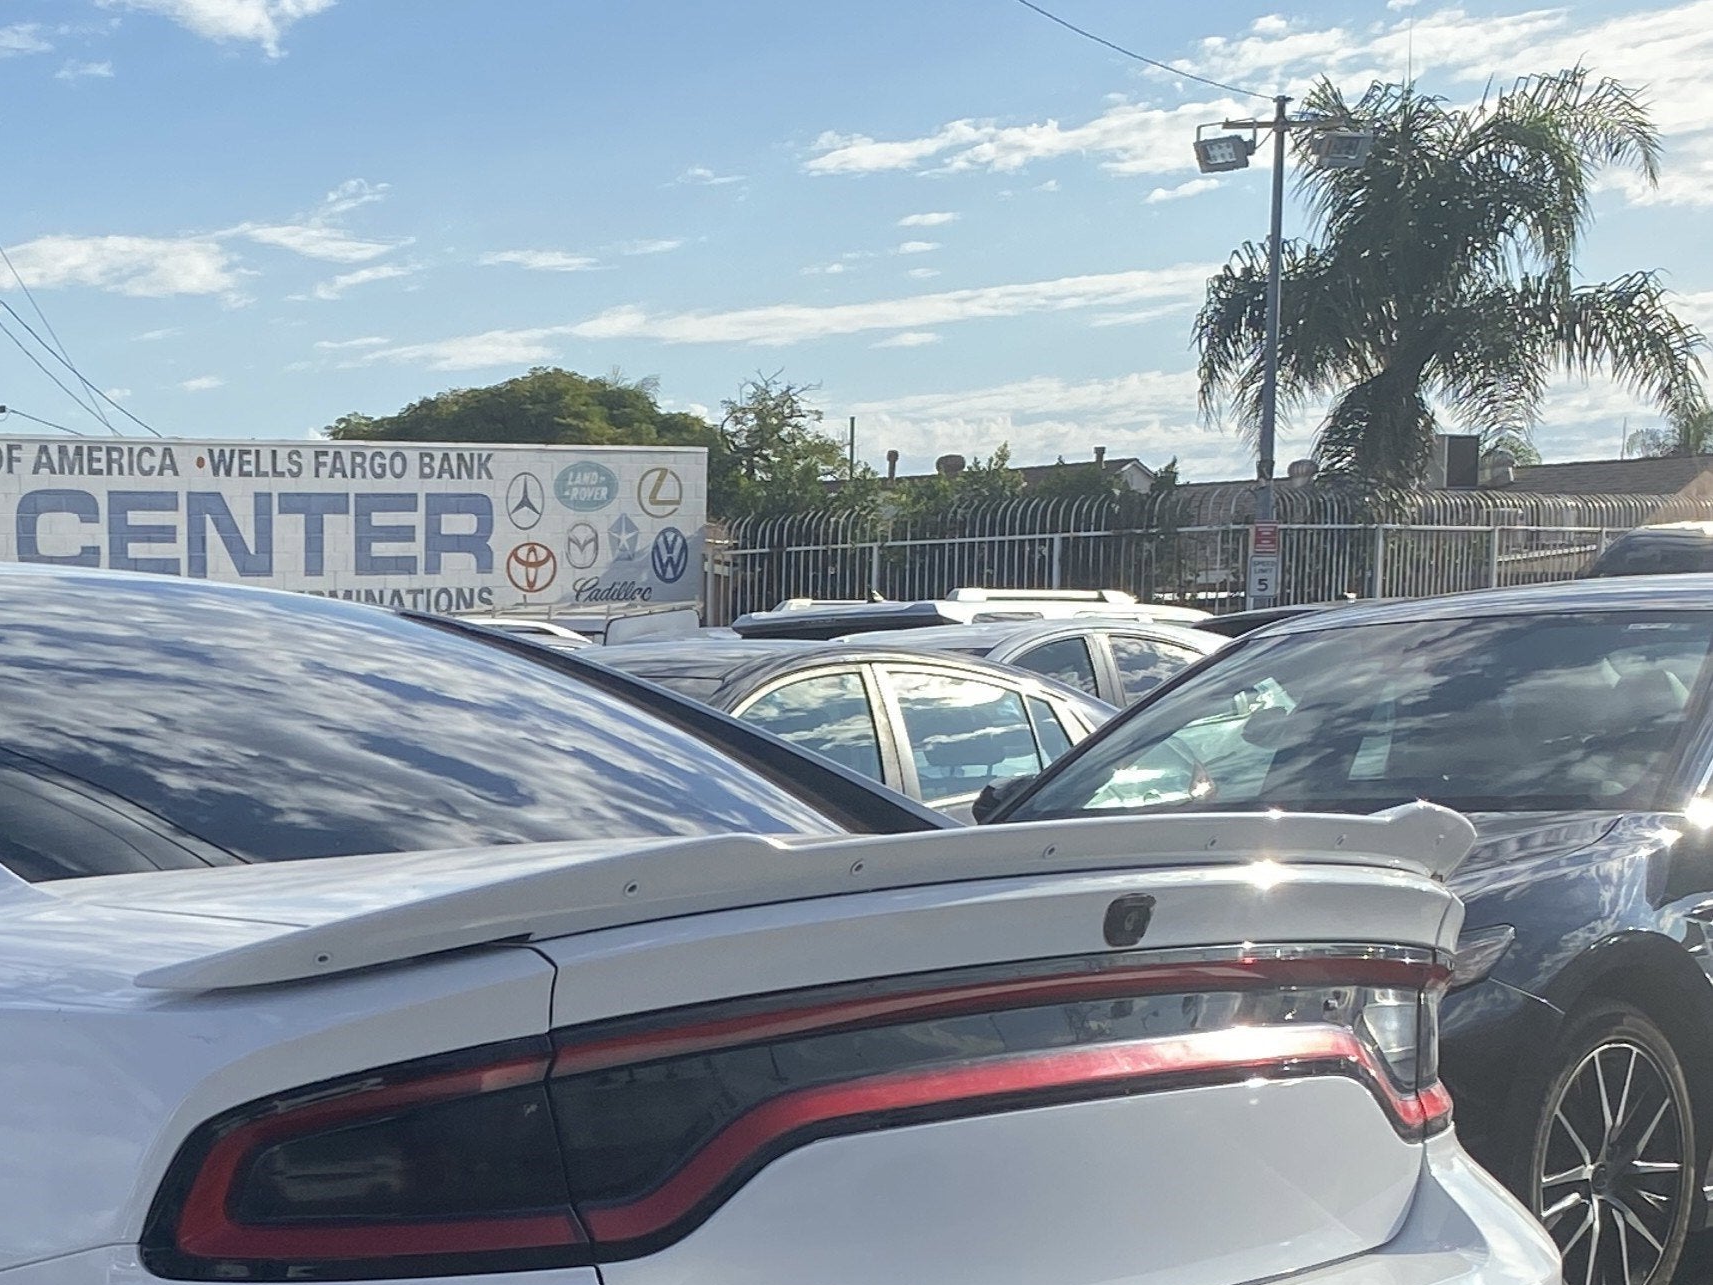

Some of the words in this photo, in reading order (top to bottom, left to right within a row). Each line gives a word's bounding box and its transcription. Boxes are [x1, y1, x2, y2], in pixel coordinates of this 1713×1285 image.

[33, 445, 179, 477] AMERICA
[207, 448, 301, 479] WELLS
[314, 450, 407, 480] FARGO
[419, 452, 493, 481] BANK
[567, 471, 599, 486] LAND
[571, 486, 608, 501] ROVER
[16, 489, 493, 578] CENTER
[573, 576, 652, 602] Cadillac
[1257, 578, 1269, 592] 5
